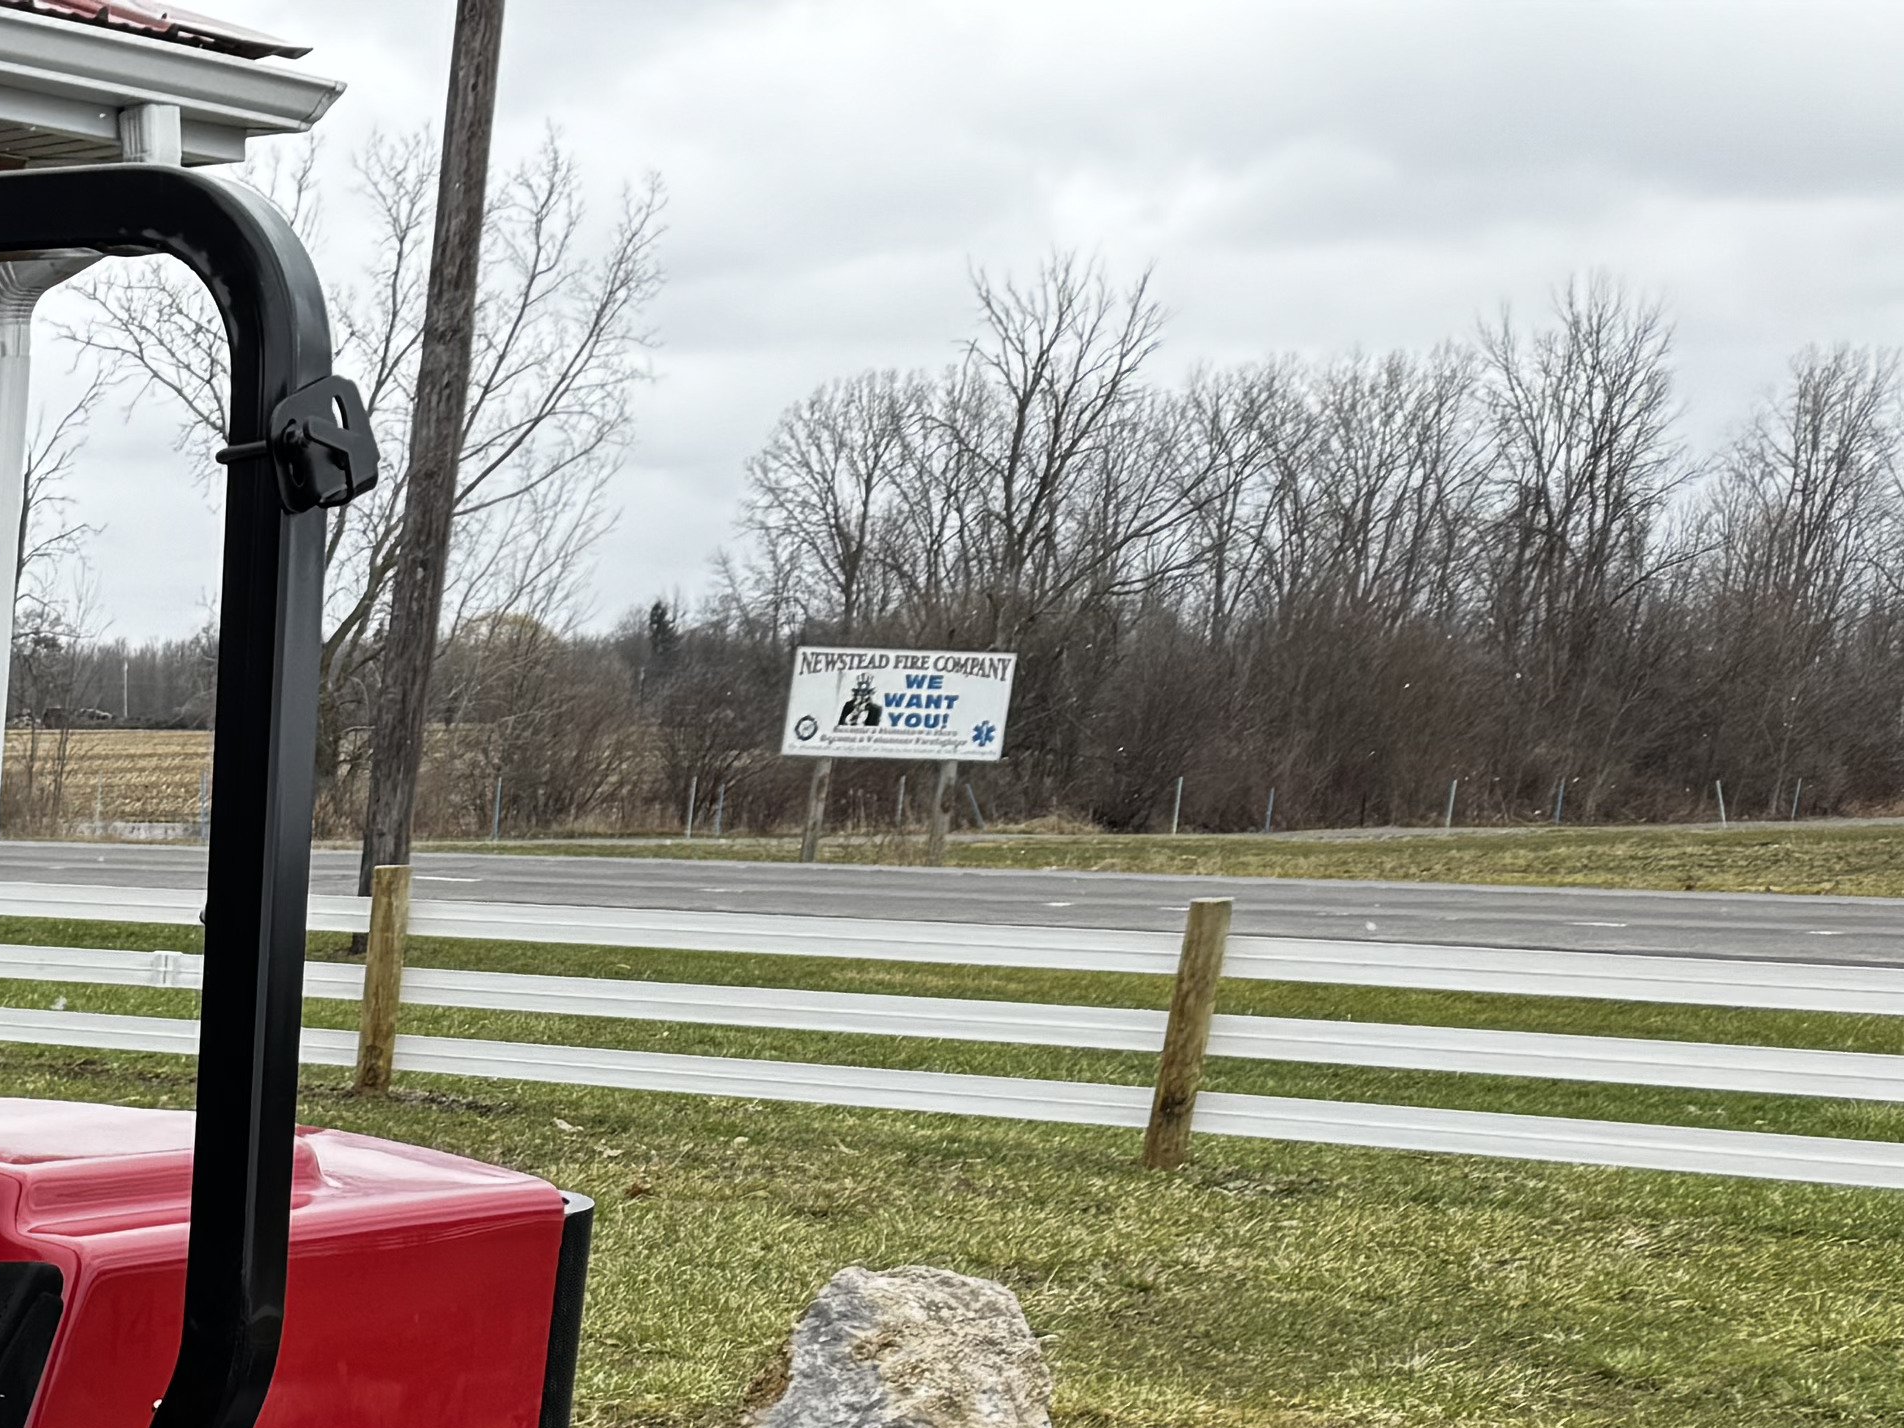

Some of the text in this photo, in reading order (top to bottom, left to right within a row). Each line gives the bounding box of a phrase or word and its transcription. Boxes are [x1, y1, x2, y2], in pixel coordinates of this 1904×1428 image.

[799, 652, 1012, 681] NEWSTEAD FIRE COMPANY
[905, 674, 944, 690] WE
[884, 692, 959, 709] WANT
[887, 712, 949, 729] YOU!
